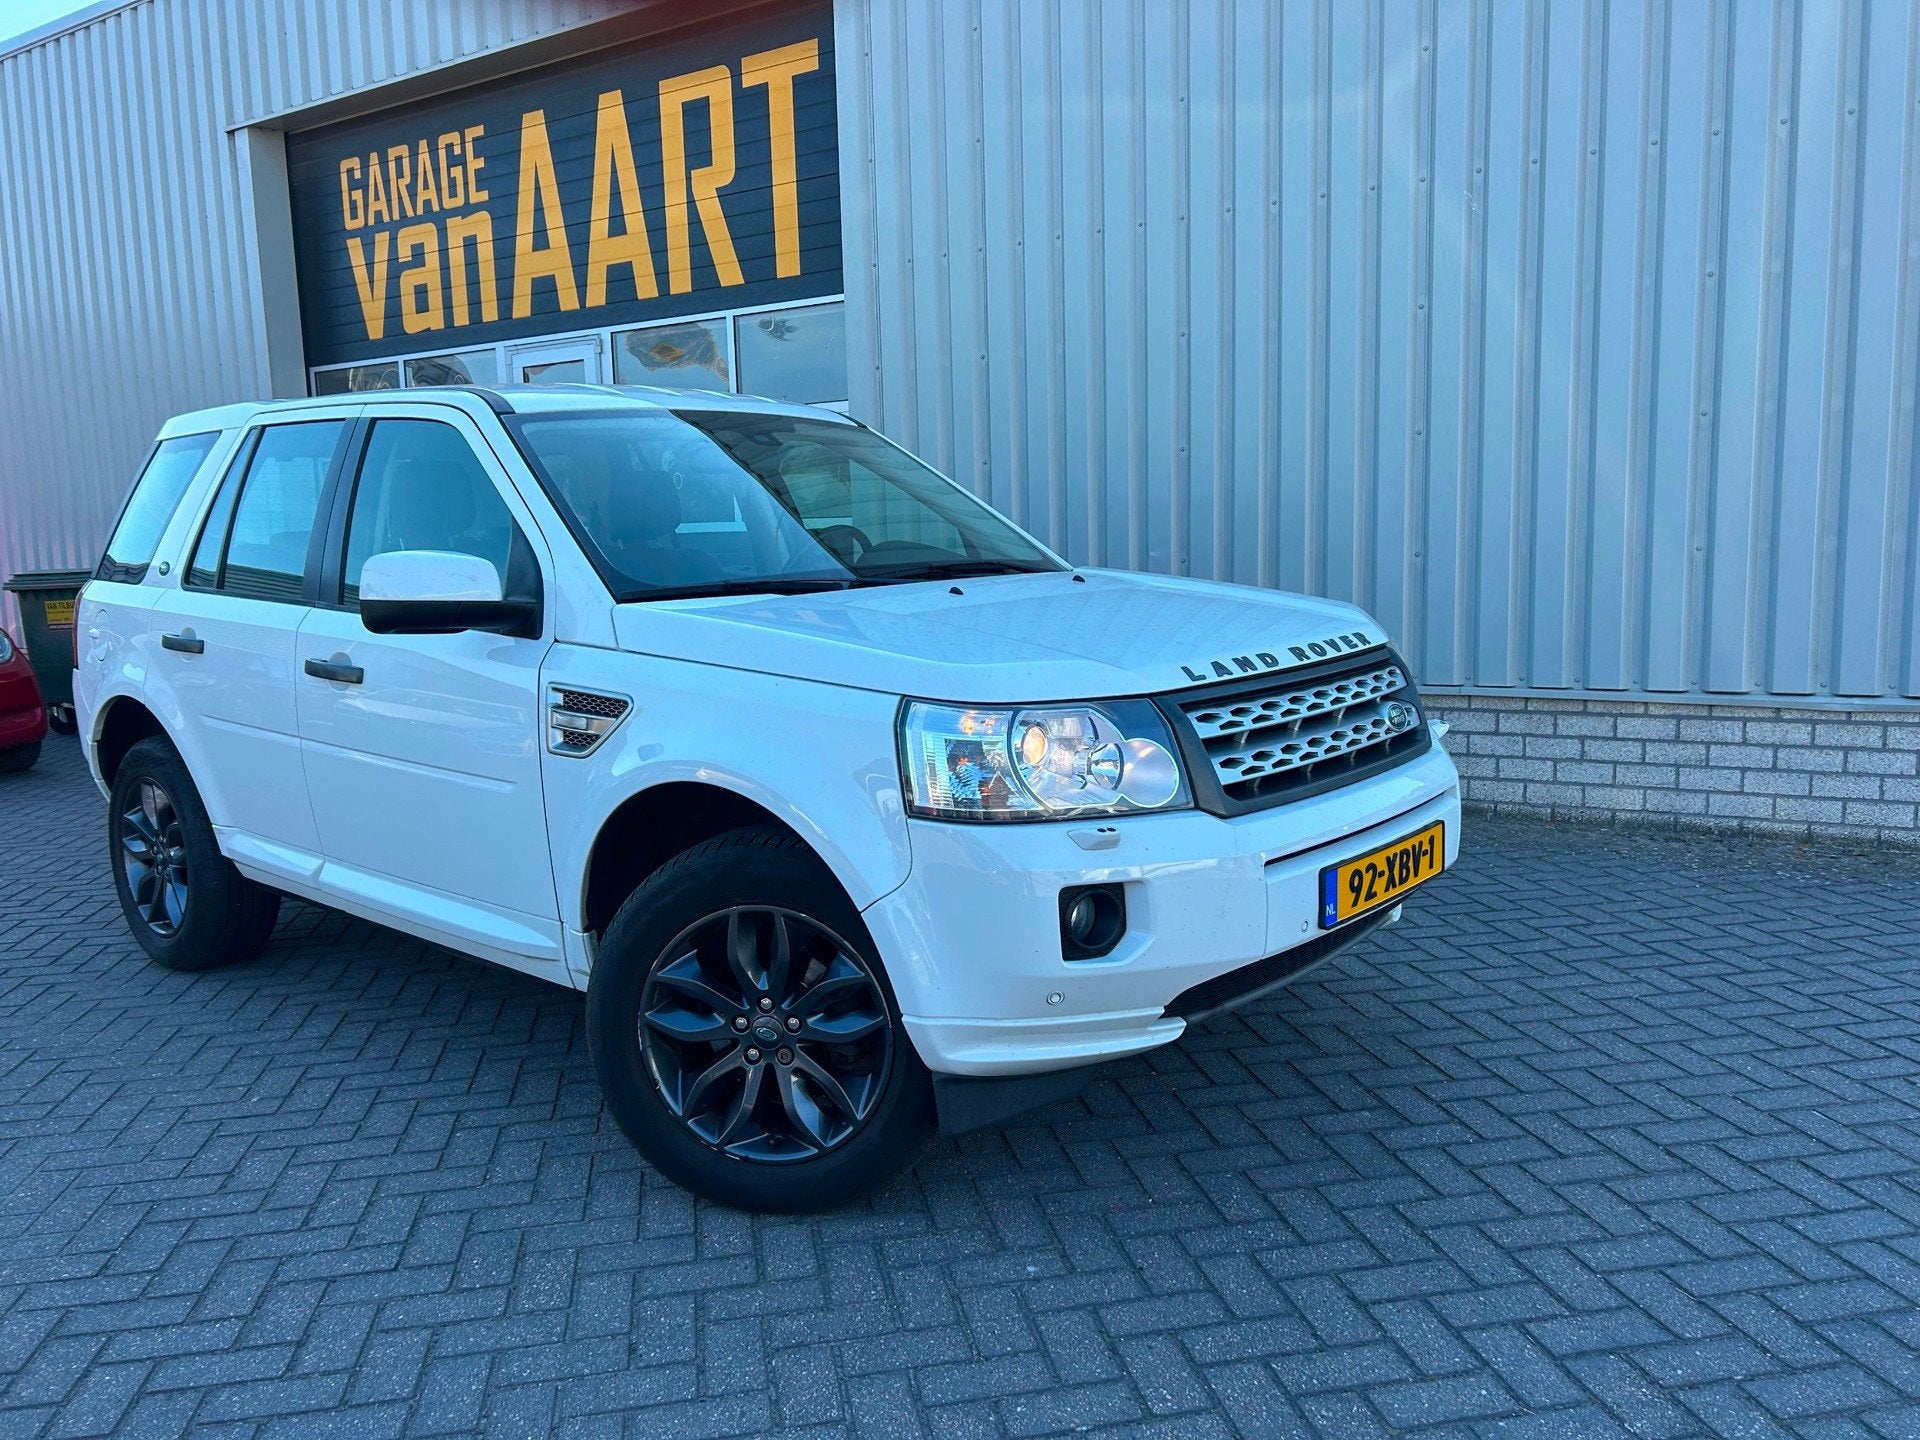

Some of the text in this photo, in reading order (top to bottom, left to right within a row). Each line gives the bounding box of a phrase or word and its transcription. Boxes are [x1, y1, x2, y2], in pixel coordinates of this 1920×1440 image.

[339, 124, 490, 232] GARAGE
[346, 37, 820, 341] van AART
[1180, 631, 1372, 682] LAND ROVER
[1348, 834, 1436, 909] 92-XBV-1
[1325, 903, 1336, 917] NL
